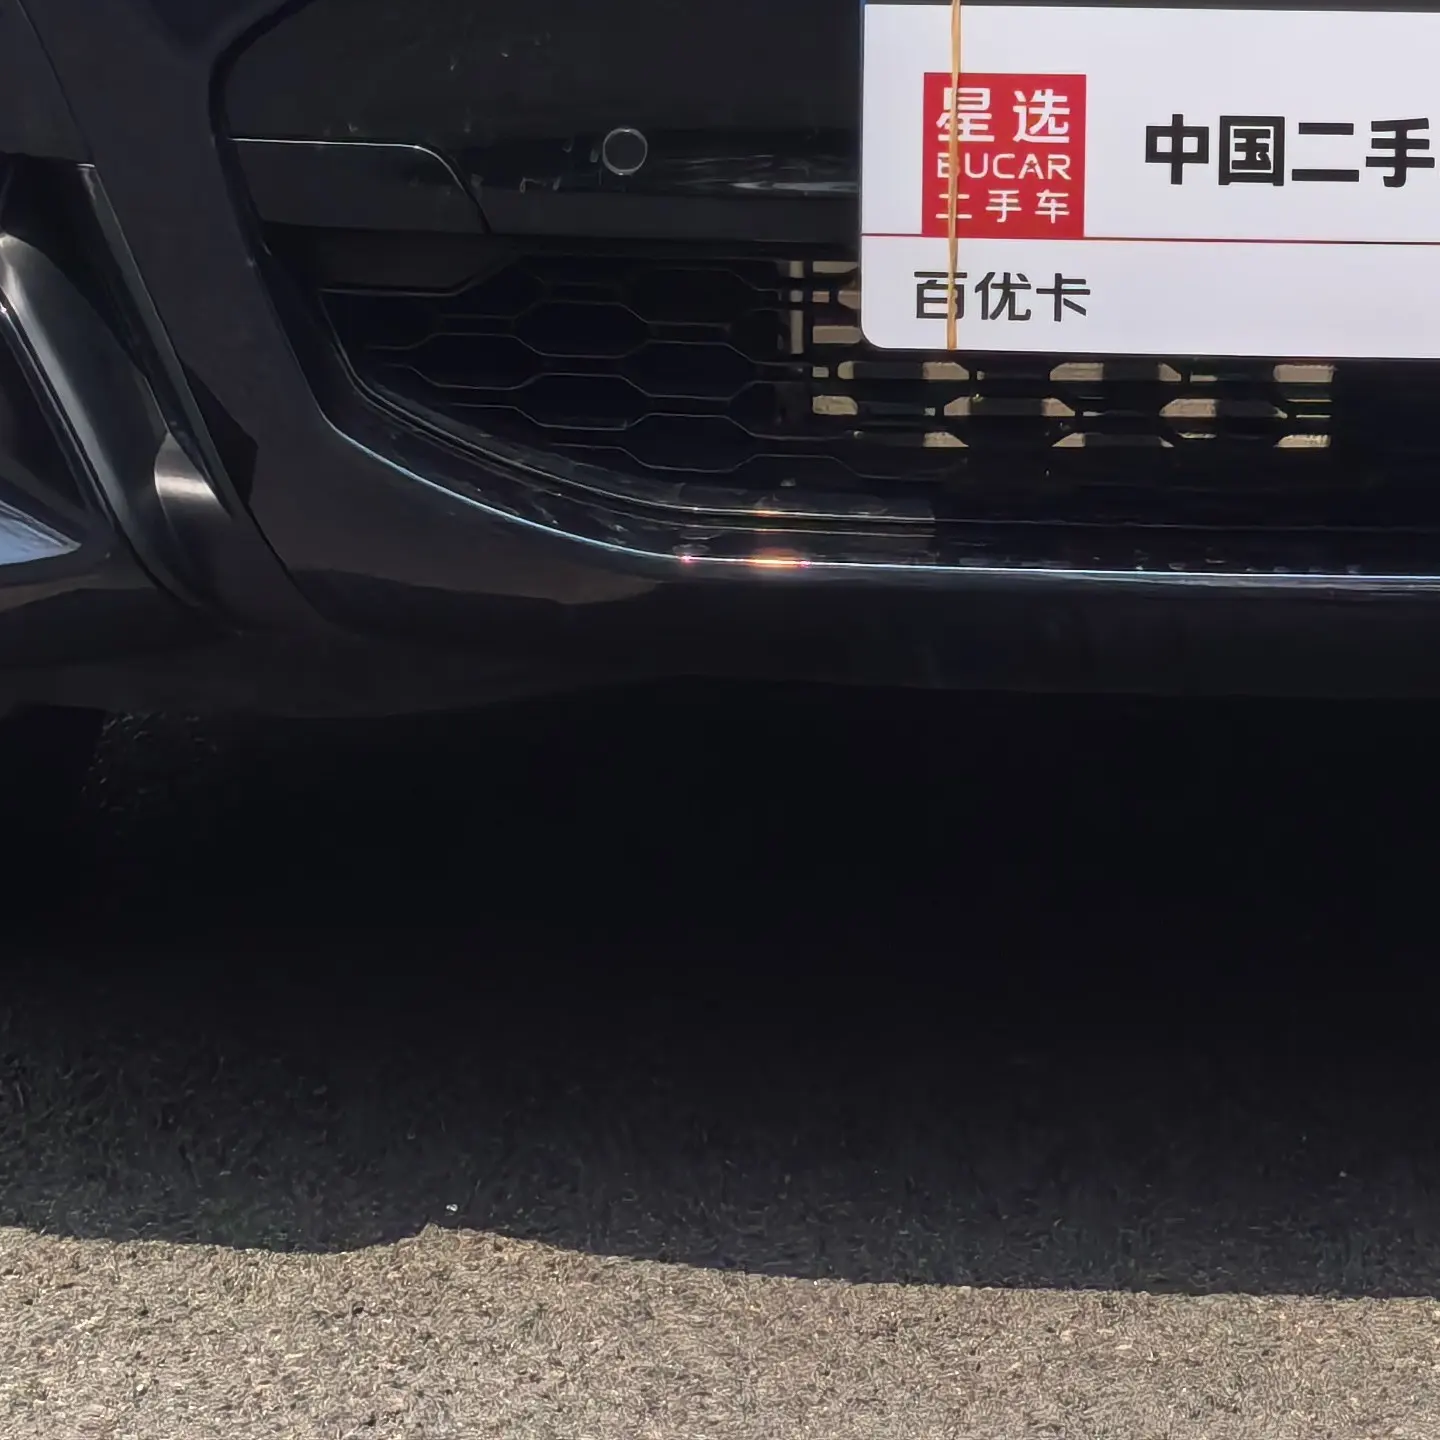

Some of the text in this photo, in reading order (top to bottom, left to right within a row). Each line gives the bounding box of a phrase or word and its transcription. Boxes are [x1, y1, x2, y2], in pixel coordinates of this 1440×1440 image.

[935, 87, 1071, 144] 星选
[937, 153, 1072, 180] BUCAR
[935, 189, 1070, 224] 二手车
[914, 271, 1091, 322] 百优卡
